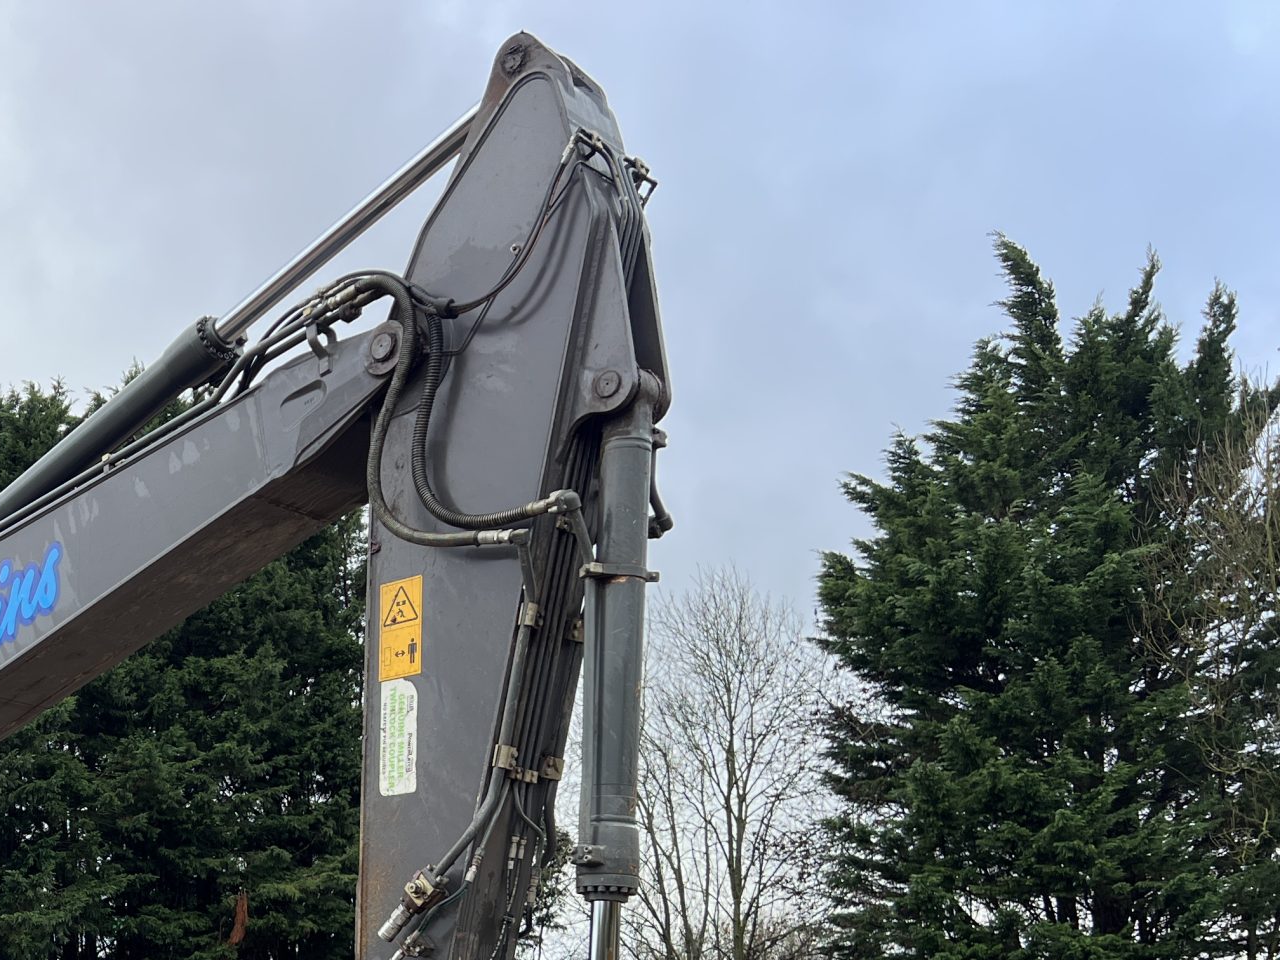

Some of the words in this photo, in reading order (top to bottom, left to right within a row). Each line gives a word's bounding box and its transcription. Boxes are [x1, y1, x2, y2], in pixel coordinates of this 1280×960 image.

[389, 687, 398, 739] TWINLOCK
[397, 694, 405, 739] GENUINE
[388, 743, 396, 788] COUPLER
[397, 742, 405, 778] MILLER
